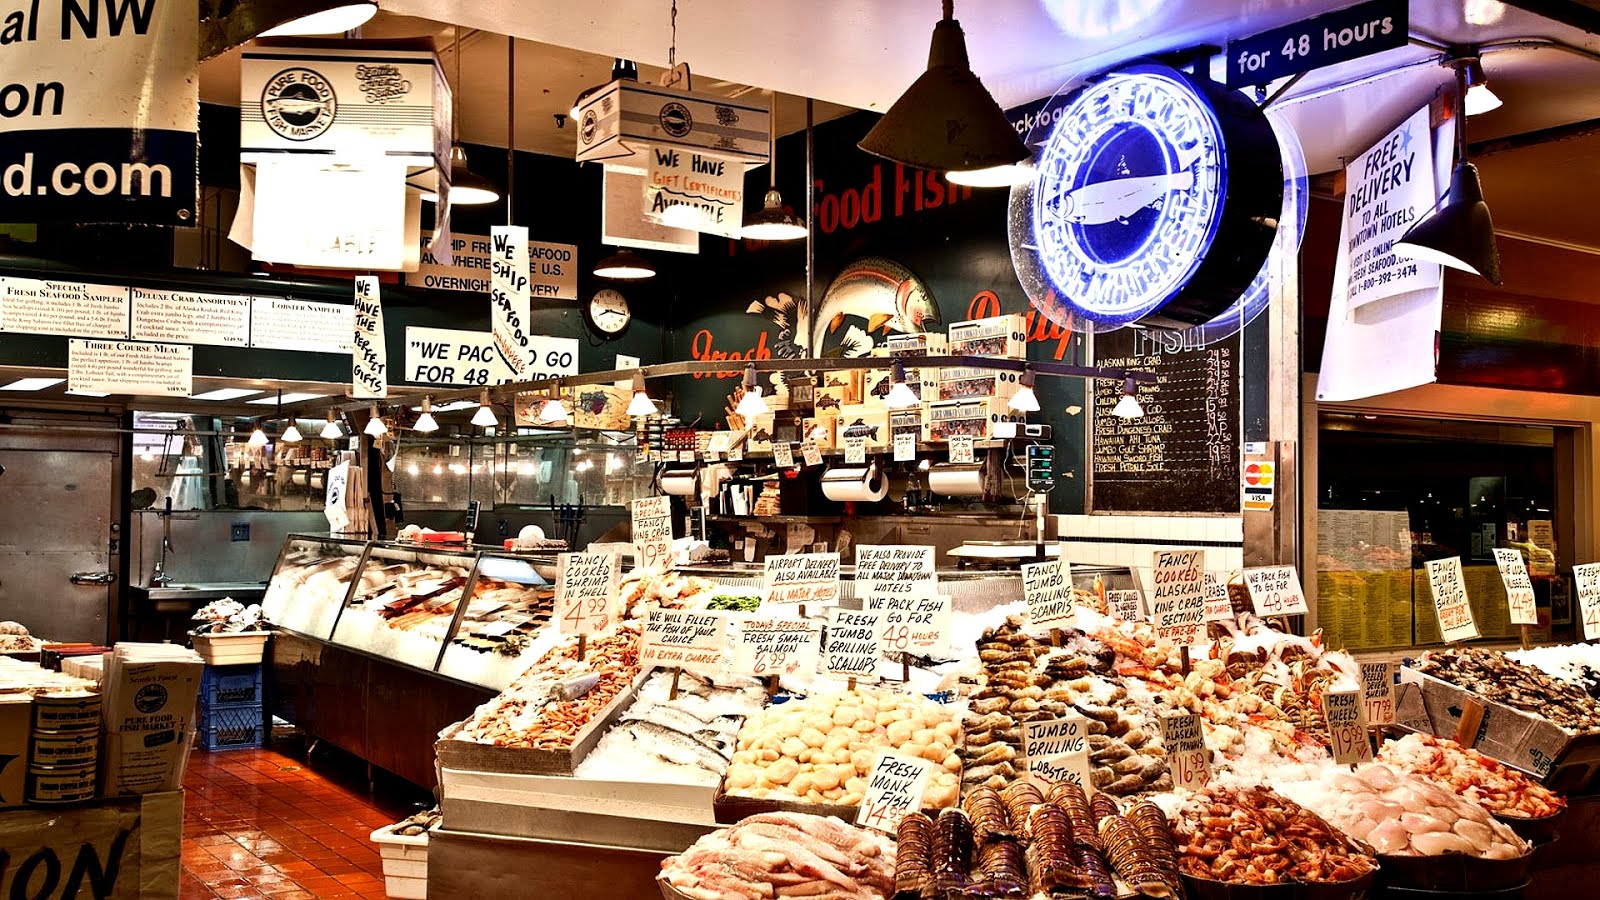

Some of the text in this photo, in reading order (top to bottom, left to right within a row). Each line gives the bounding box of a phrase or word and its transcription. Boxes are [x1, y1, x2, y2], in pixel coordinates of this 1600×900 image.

[61, 0, 156, 40] NW
[1238, 16, 1394, 73] for 48 hours
[268, 73, 296, 97] PURE
[301, 73, 331, 97] FOOD
[0, 80, 65, 118] on
[267, 106, 288, 132] FISH
[1035, 111, 1051, 128] to
[654, 148, 725, 177] WE HAVE
[1364, 133, 1399, 180] FREE
[653, 171, 742, 200] GIFT CERTIFICATES
[1350, 151, 1415, 219] DELIVERY
[1362, 200, 1389, 228] TO ALL
[1381, 206, 1415, 234] HOTELS
[494, 234, 515, 260] WE
[1364, 249, 1371, 262] US
[492, 261, 526, 291] SHIP
[542, 263, 564, 275] U.S.
[1358, 264, 1418, 293] 1-800-392-3474
[45, 281, 87, 293] SPECIAL!
[356, 281, 371, 296] WE
[7, 286, 37, 298] FRESH
[39, 289, 81, 301] SEAFOOD
[82, 292, 123, 304] SAMPLER
[135, 290, 248, 306] DELUXE CRAB ASSORTMENT
[354, 299, 379, 317] HAVE
[356, 314, 376, 331] THE
[492, 288, 528, 346] SEAFOOD
[83, 340, 180, 354] THREE COURSE MEAL
[354, 331, 385, 375] PERFECT
[546, 351, 572, 368] GO
[1096, 355, 1162, 368] ALASKAN KING CRAB
[353, 365, 382, 392] GIFTS
[415, 366, 455, 384] FOR
[463, 369, 489, 386] 48
[1146, 404, 1162, 415] COD
[1154, 424, 1173, 434] CRAB
[634, 508, 666, 519] SPECIAL
[638, 517, 666, 529] FANCY
[634, 526, 671, 540] KING CRAB
[570, 554, 609, 568] FANCY
[860, 549, 928, 560] WE ALSO PROVIDE
[1158, 552, 1198, 570] FANCY
[1498, 551, 1518, 562] FRESH
[566, 565, 610, 577] COOKED
[768, 557, 838, 571] AIRPORT DELIVERY
[858, 561, 923, 572] FREE DELIVERY TO
[1027, 561, 1063, 578] FANCY
[1432, 559, 1457, 575] FANCY
[566, 576, 609, 588] SHRIMP
[775, 569, 838, 582] ALSO AVAILABLE
[857, 571, 933, 582] ALL MAJOR DOWNTOWN
[1026, 574, 1063, 591] JUMBO
[1247, 569, 1291, 583] WE PACK FISH
[1432, 572, 1457, 587] JUMBO
[1583, 575, 1598, 588] LIVE
[564, 586, 608, 599] IN SHELL
[1154, 581, 1202, 599] ALASKAN
[1253, 583, 1263, 593] TO
[1276, 580, 1288, 590] FOR
[1438, 582, 1458, 597] GULF
[768, 588, 811, 602] ALL MAJOR
[1027, 586, 1071, 606] GRILLING
[1264, 592, 1282, 611] 48
[1437, 590, 1464, 609] SHRIMP
[869, 596, 944, 612] WE PACK FISH
[1154, 596, 1203, 614] KING CRAB
[649, 611, 718, 627] WE WILL FILLET
[776, 621, 811, 630] SPECIAL
[836, 613, 878, 627] FRESH
[887, 612, 933, 624] GO FOR
[646, 623, 717, 638] THE FISH OF YOUR
[743, 633, 810, 643] FRESH SMALL
[831, 627, 873, 640] JUMBO
[882, 625, 940, 649] 48 HOURS
[1159, 628, 1170, 638] WE
[661, 634, 694, 645] CHOICE
[756, 643, 798, 655] SALMON
[828, 641, 877, 655] GRILLING
[644, 649, 721, 664] NO EXTRA CHARGE
[827, 656, 878, 673] SCALLOPS
[1362, 663, 1387, 673] COOKED
[1328, 693, 1356, 708] FRESH
[150, 714, 174, 723] FOOD
[1328, 705, 1358, 723] CHEEKS
[120, 721, 176, 732] FISH MARKET
[1028, 722, 1077, 739] JUMBO
[1167, 716, 1195, 730] FRESH
[1166, 726, 1199, 741] ALASKAN
[1027, 736, 1084, 757] GRILLING
[876, 756, 924, 779] FRESH
[869, 774, 914, 794] MONK
[877, 791, 915, 810] FISH
